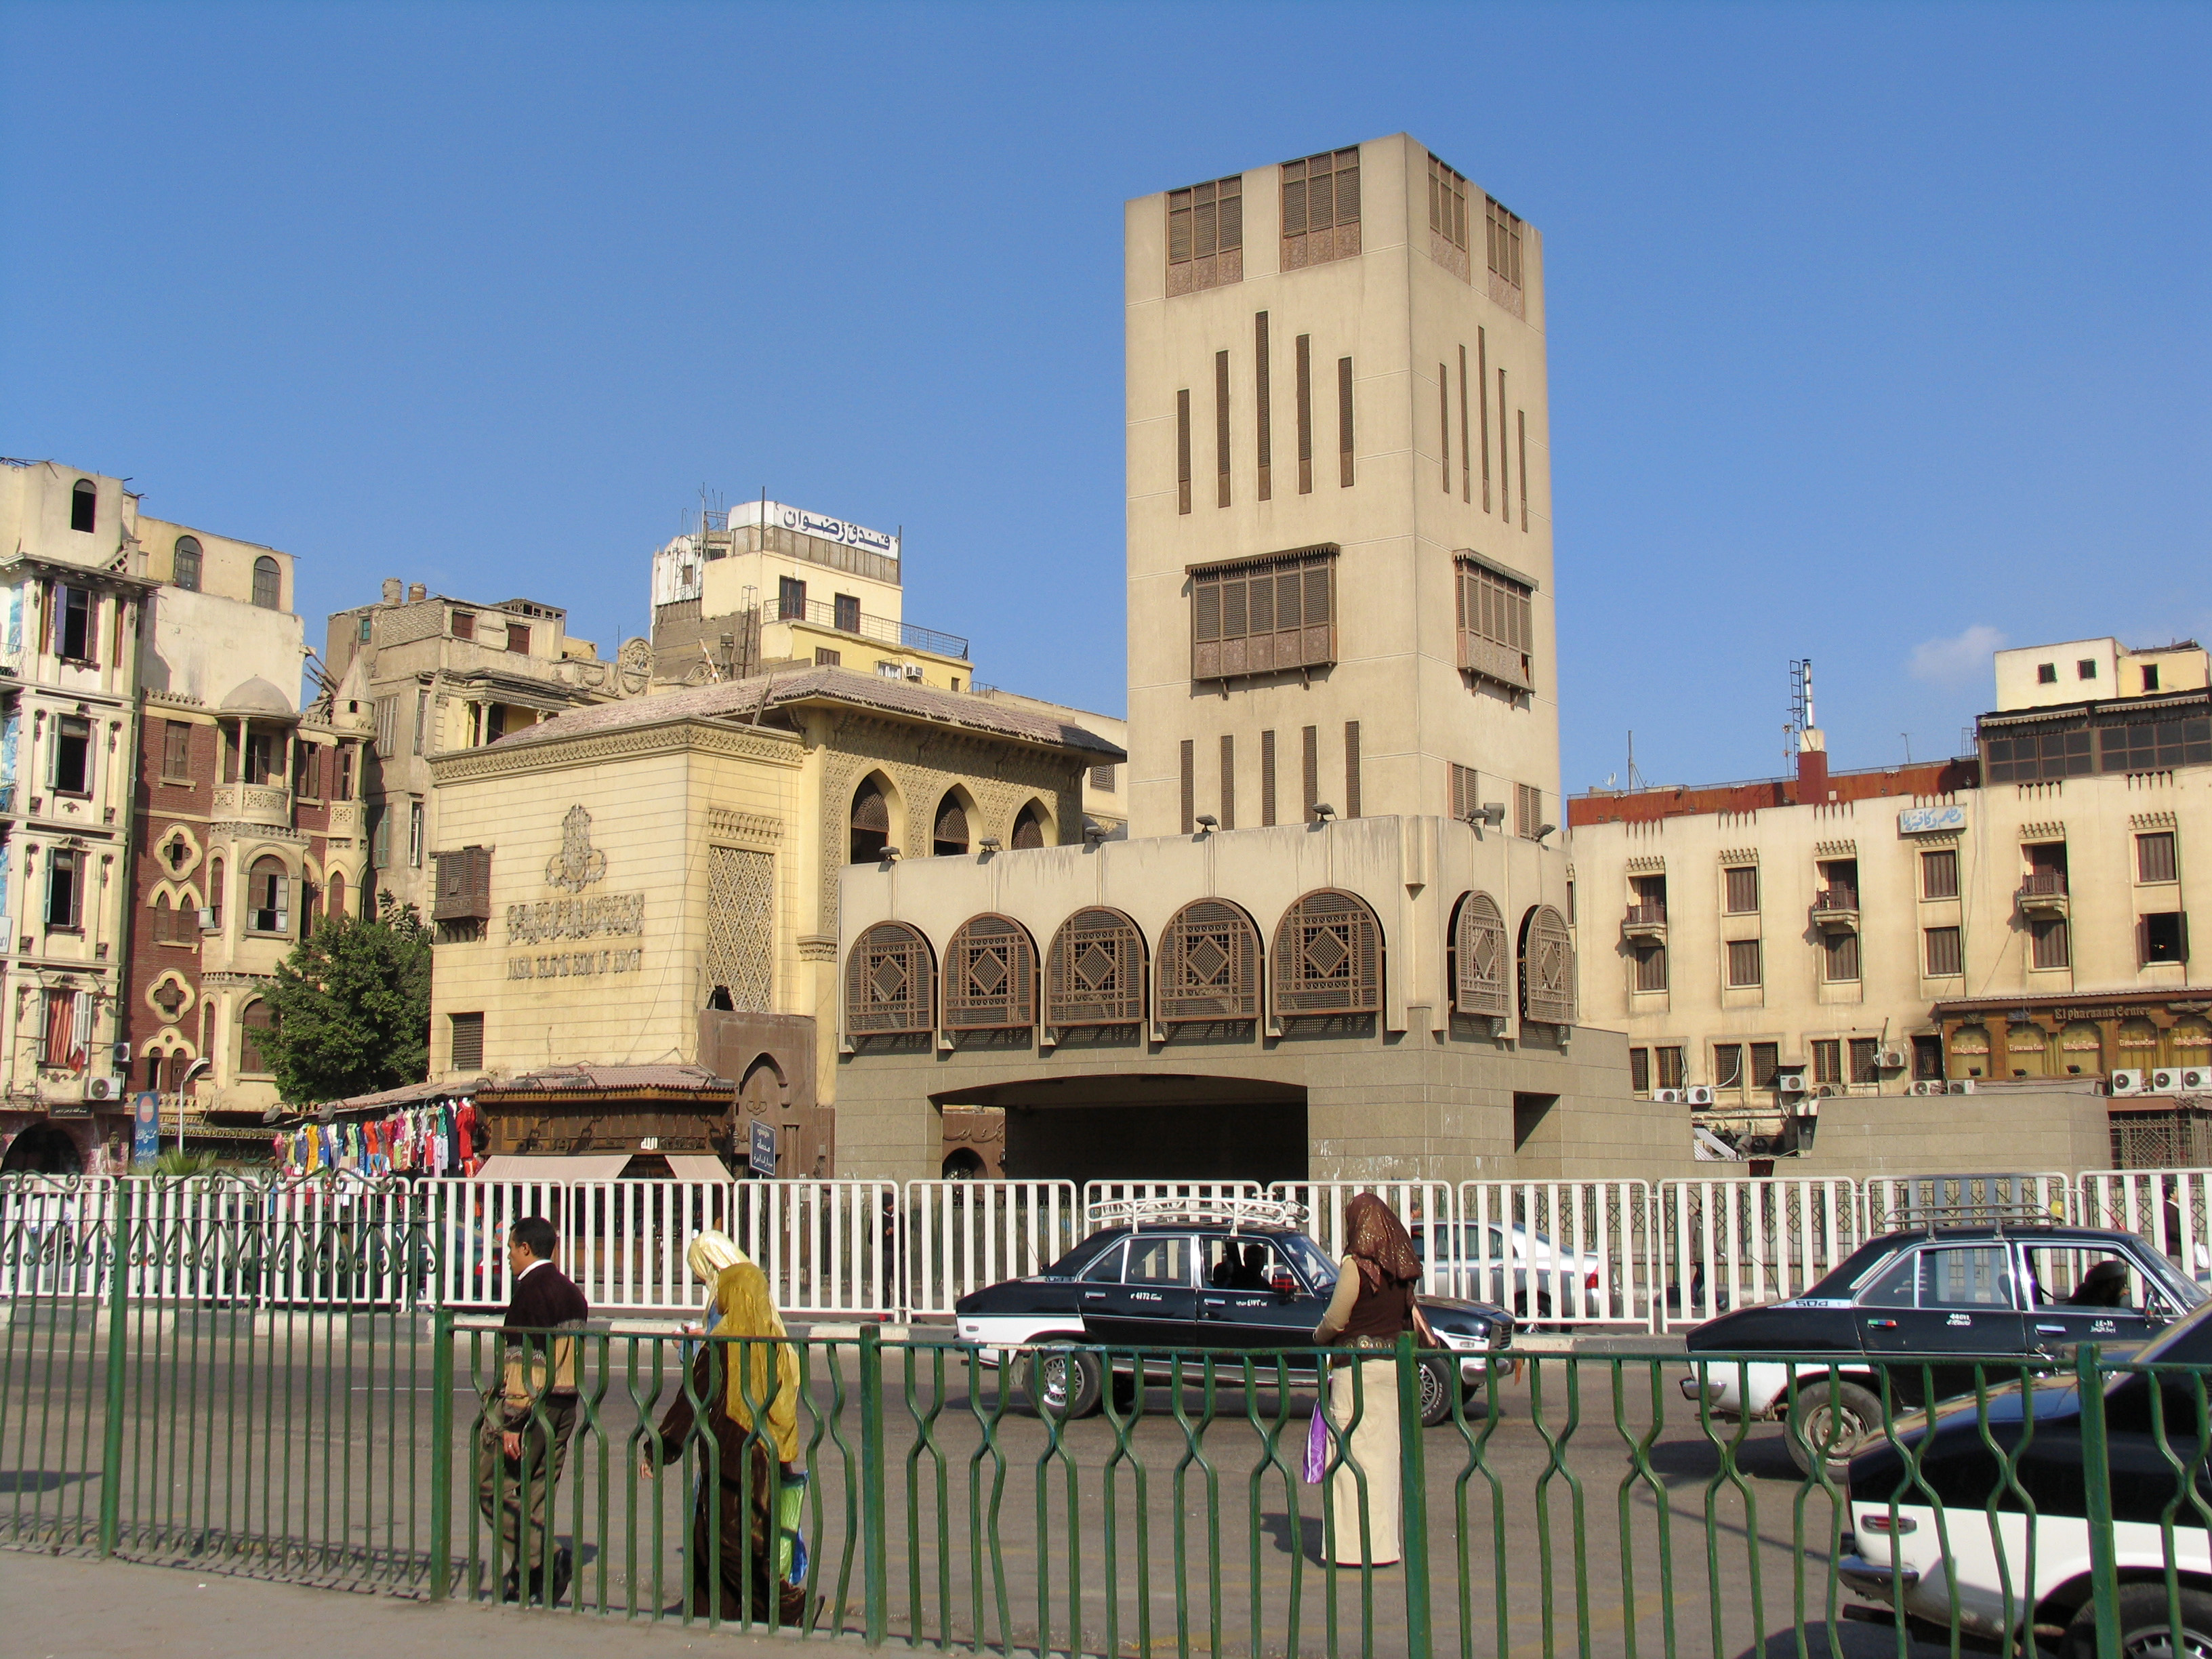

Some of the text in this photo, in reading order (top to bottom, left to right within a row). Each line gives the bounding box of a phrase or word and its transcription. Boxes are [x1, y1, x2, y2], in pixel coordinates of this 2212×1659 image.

[783, 509, 890, 551] فندق رضوان
[537, 953, 569, 979] ISLAMIC
[573, 951, 595, 976] BANK
[598, 949, 609, 975] OF
[614, 948, 642, 972] EGYPT
[756, 1138, 771, 1153] محطة
